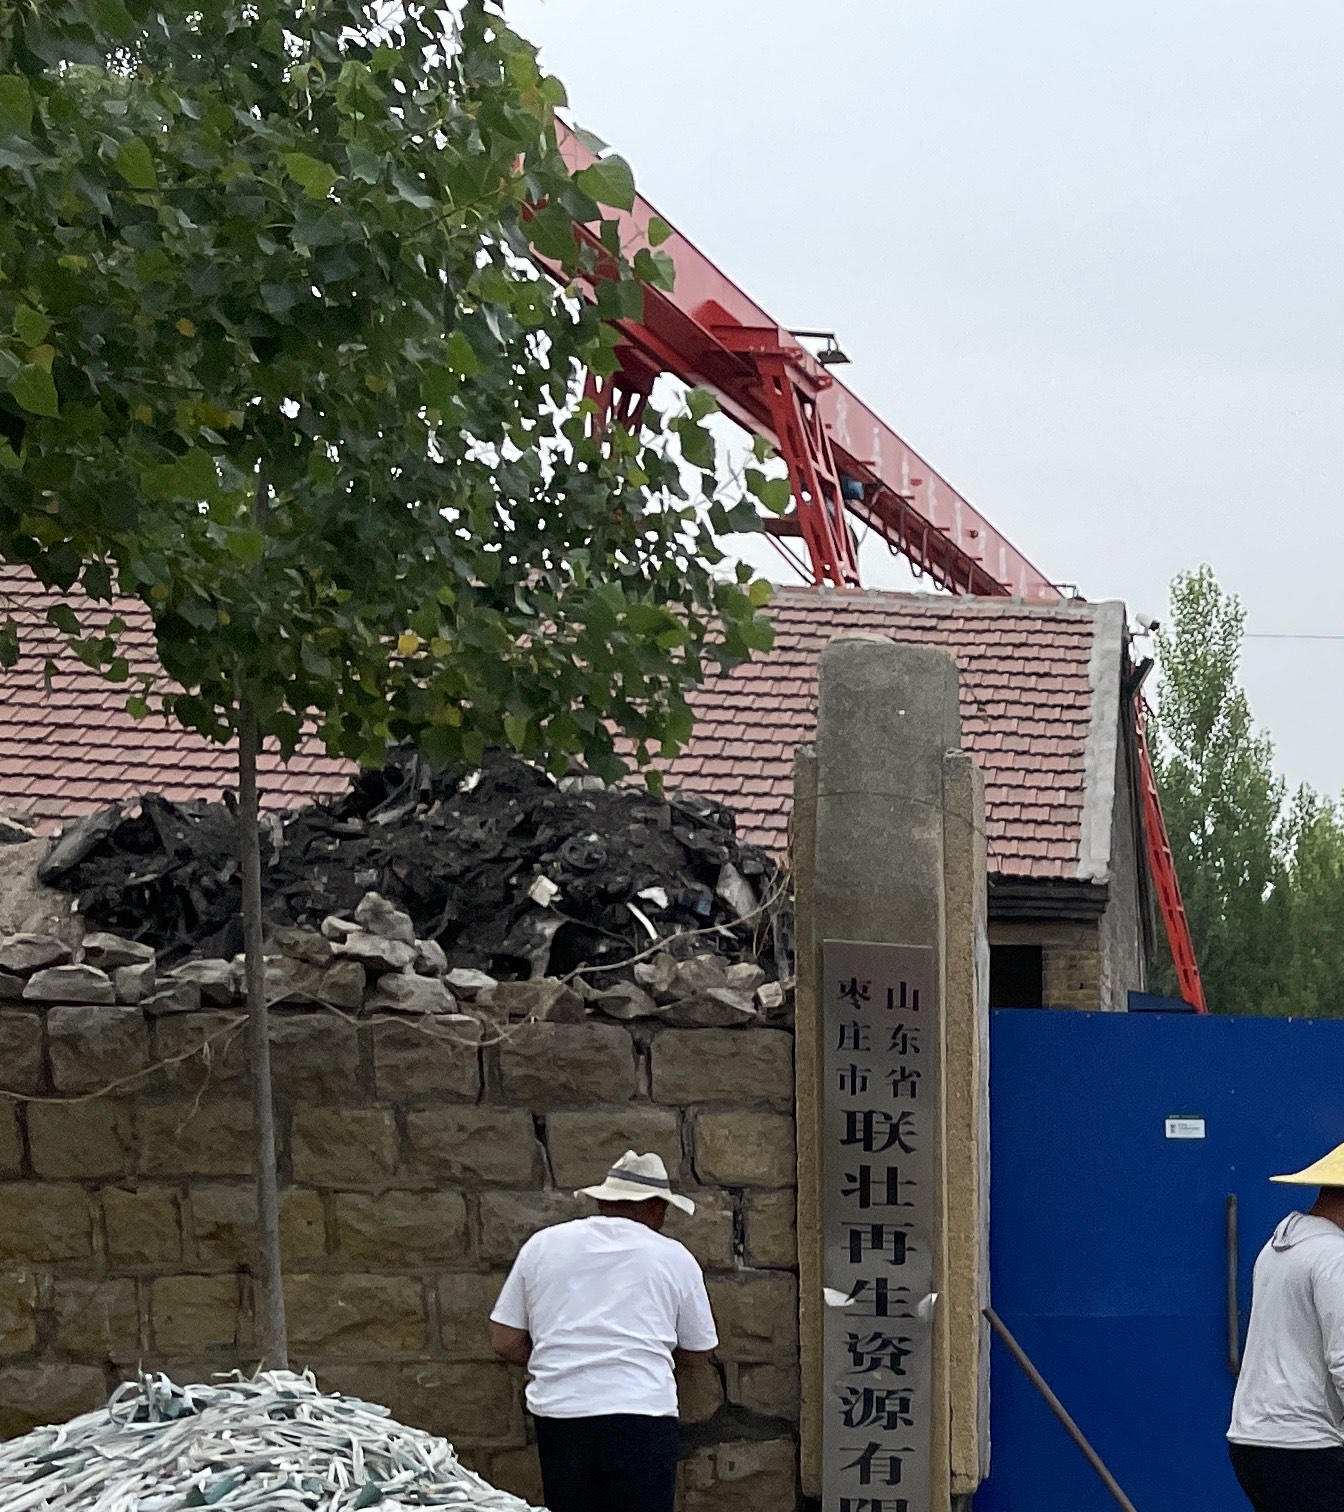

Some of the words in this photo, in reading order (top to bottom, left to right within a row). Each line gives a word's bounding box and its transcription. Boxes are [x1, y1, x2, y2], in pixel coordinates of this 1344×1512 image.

[836, 977, 872, 1096] 枣庄市
[885, 981, 921, 1099] 山东省
